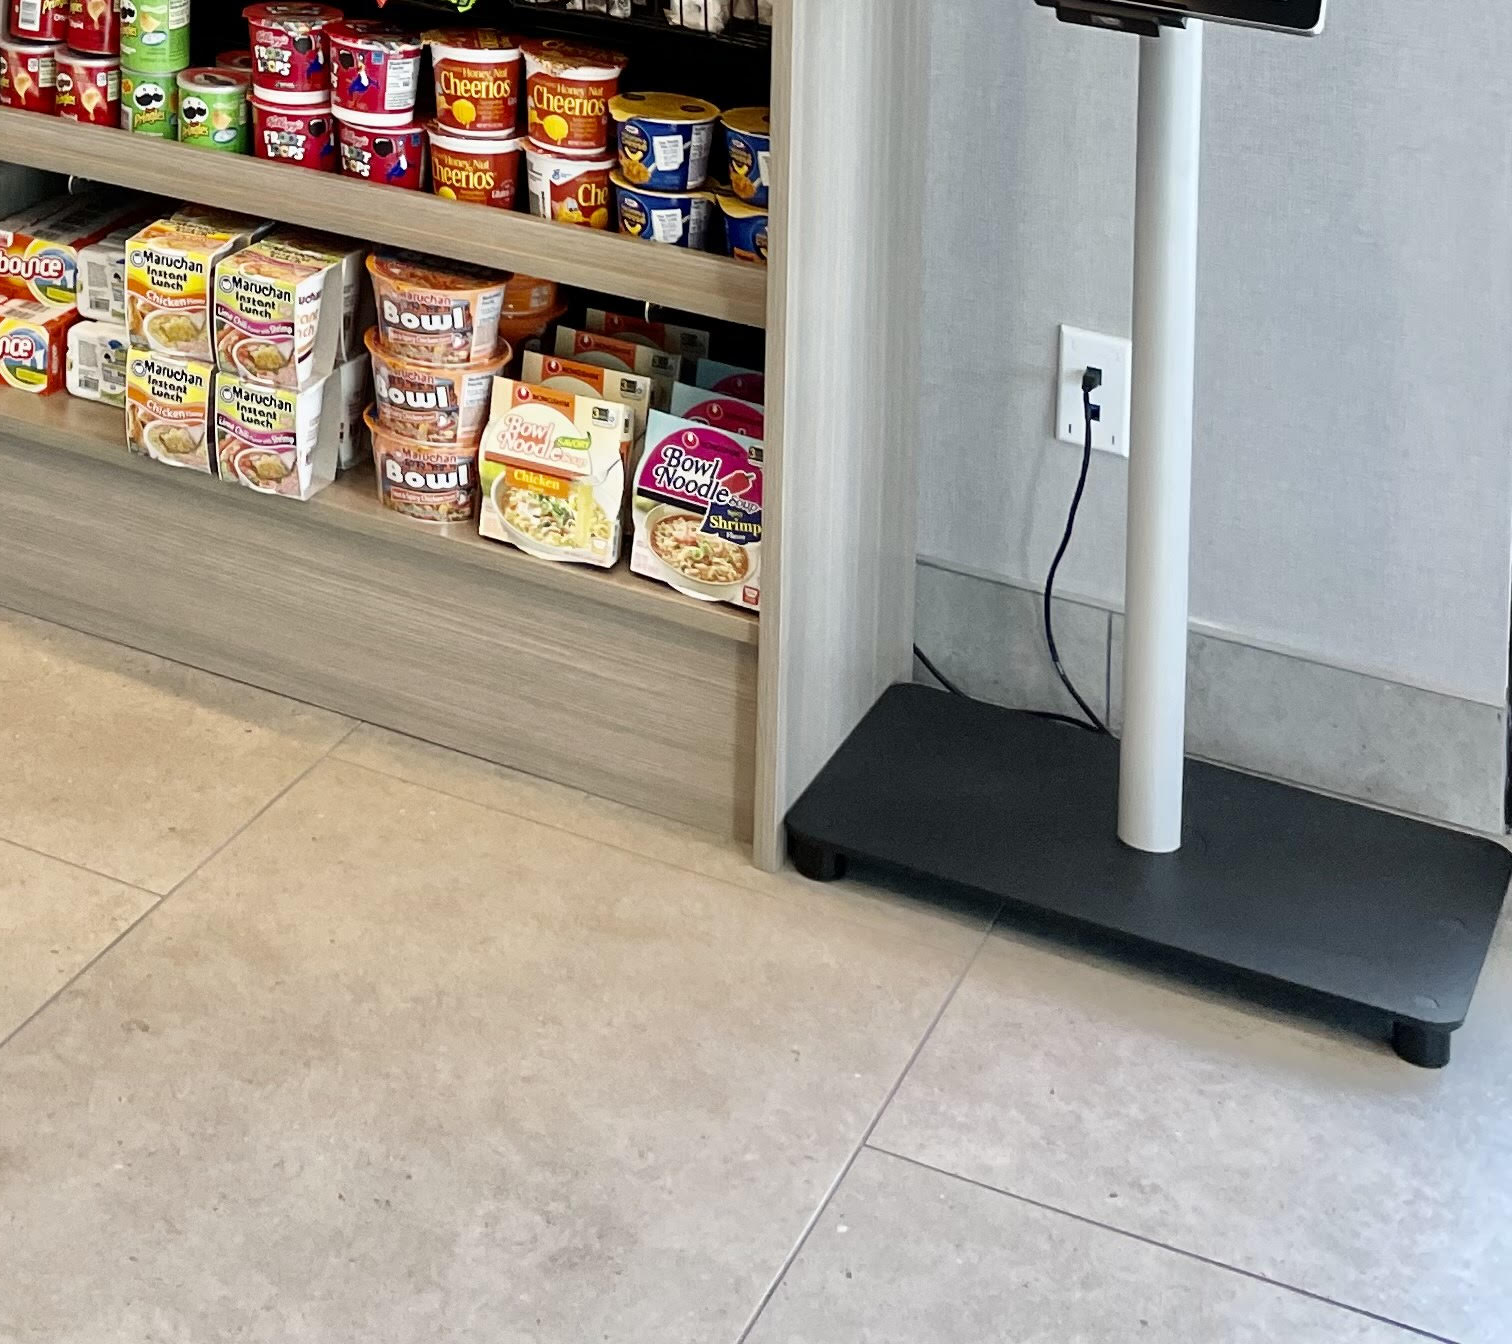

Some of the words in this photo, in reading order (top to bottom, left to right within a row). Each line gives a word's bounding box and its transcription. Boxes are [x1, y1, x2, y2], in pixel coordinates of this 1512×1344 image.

[462, 67, 491, 81] Honey
[493, 68, 508, 79] Nut
[440, 71, 511, 99] Cheerios
[557, 83, 586, 97] Honey
[589, 86, 604, 95] Nut
[533, 84, 606, 116] Cheerios
[476, 160, 490, 170] Nut
[143, 250, 203, 274] Maruchan
[146, 265, 188, 282] Instant
[151, 276, 184, 292] Lunch
[145, 290, 188, 307] Chicken
[232, 276, 291, 302] Maruchan
[236, 291, 276, 310] Instant
[239, 302, 272, 320] Lunch
[384, 300, 463, 331] Bowl
[143, 359, 203, 387] Maruchan
[146, 375, 188, 394] Instant
[376, 379, 448, 409] Bowl
[150, 387, 184, 404] Lunch
[232, 385, 292, 412] Maruchan
[145, 399, 186, 419] Chicken
[236, 401, 277, 421] Instant
[240, 413, 274, 429] Lunch
[504, 414, 555, 444] Bowl
[497, 431, 566, 462] Noodle
[386, 458, 468, 489] Bowl
[662, 446, 721, 480] Bowl
[513, 469, 560, 491] Chicken
[653, 465, 730, 503] Noodle
[709, 514, 762, 535] Shrimp
